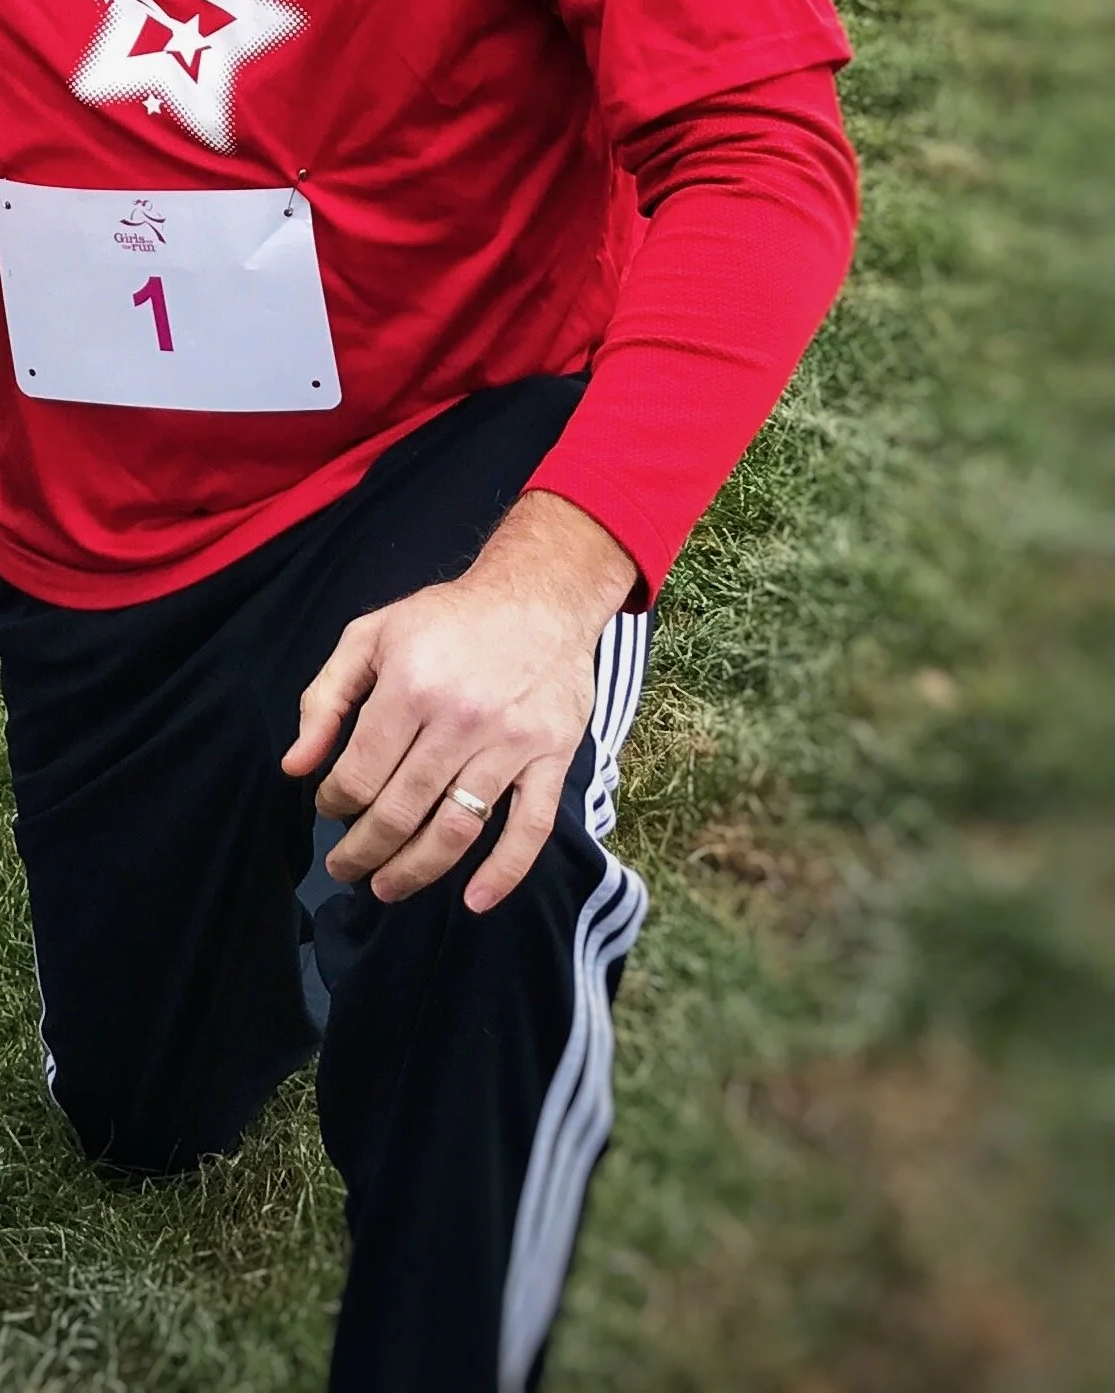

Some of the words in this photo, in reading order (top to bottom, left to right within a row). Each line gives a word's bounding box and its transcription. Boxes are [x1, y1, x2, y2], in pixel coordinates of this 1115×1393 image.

[114, 232, 145, 244] Girls
[132, 243, 156, 253] run
[132, 276, 174, 352] 1
